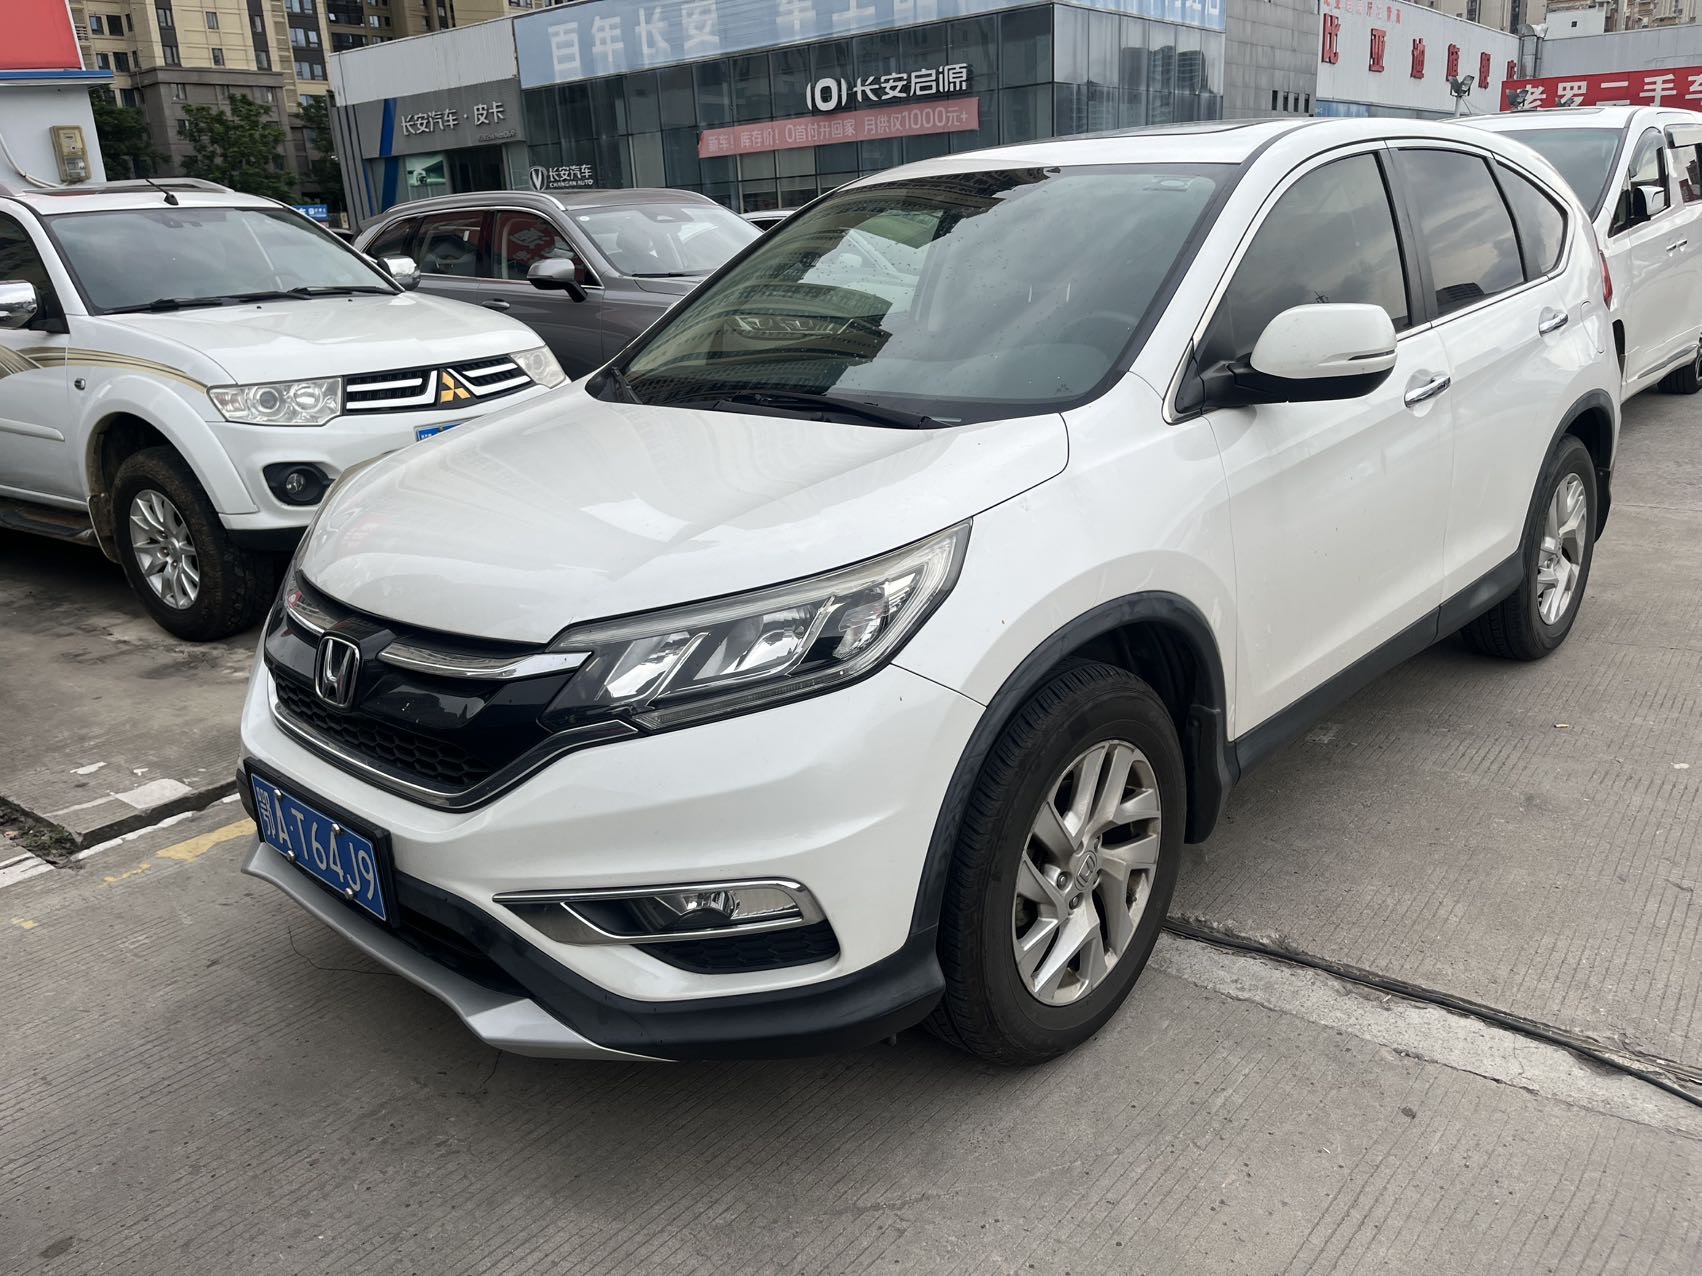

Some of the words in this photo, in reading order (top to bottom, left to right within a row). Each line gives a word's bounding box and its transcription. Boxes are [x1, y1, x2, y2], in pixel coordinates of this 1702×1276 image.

[853, 63, 969, 102] 长安启源
[549, 164, 593, 182] 长安汽车
